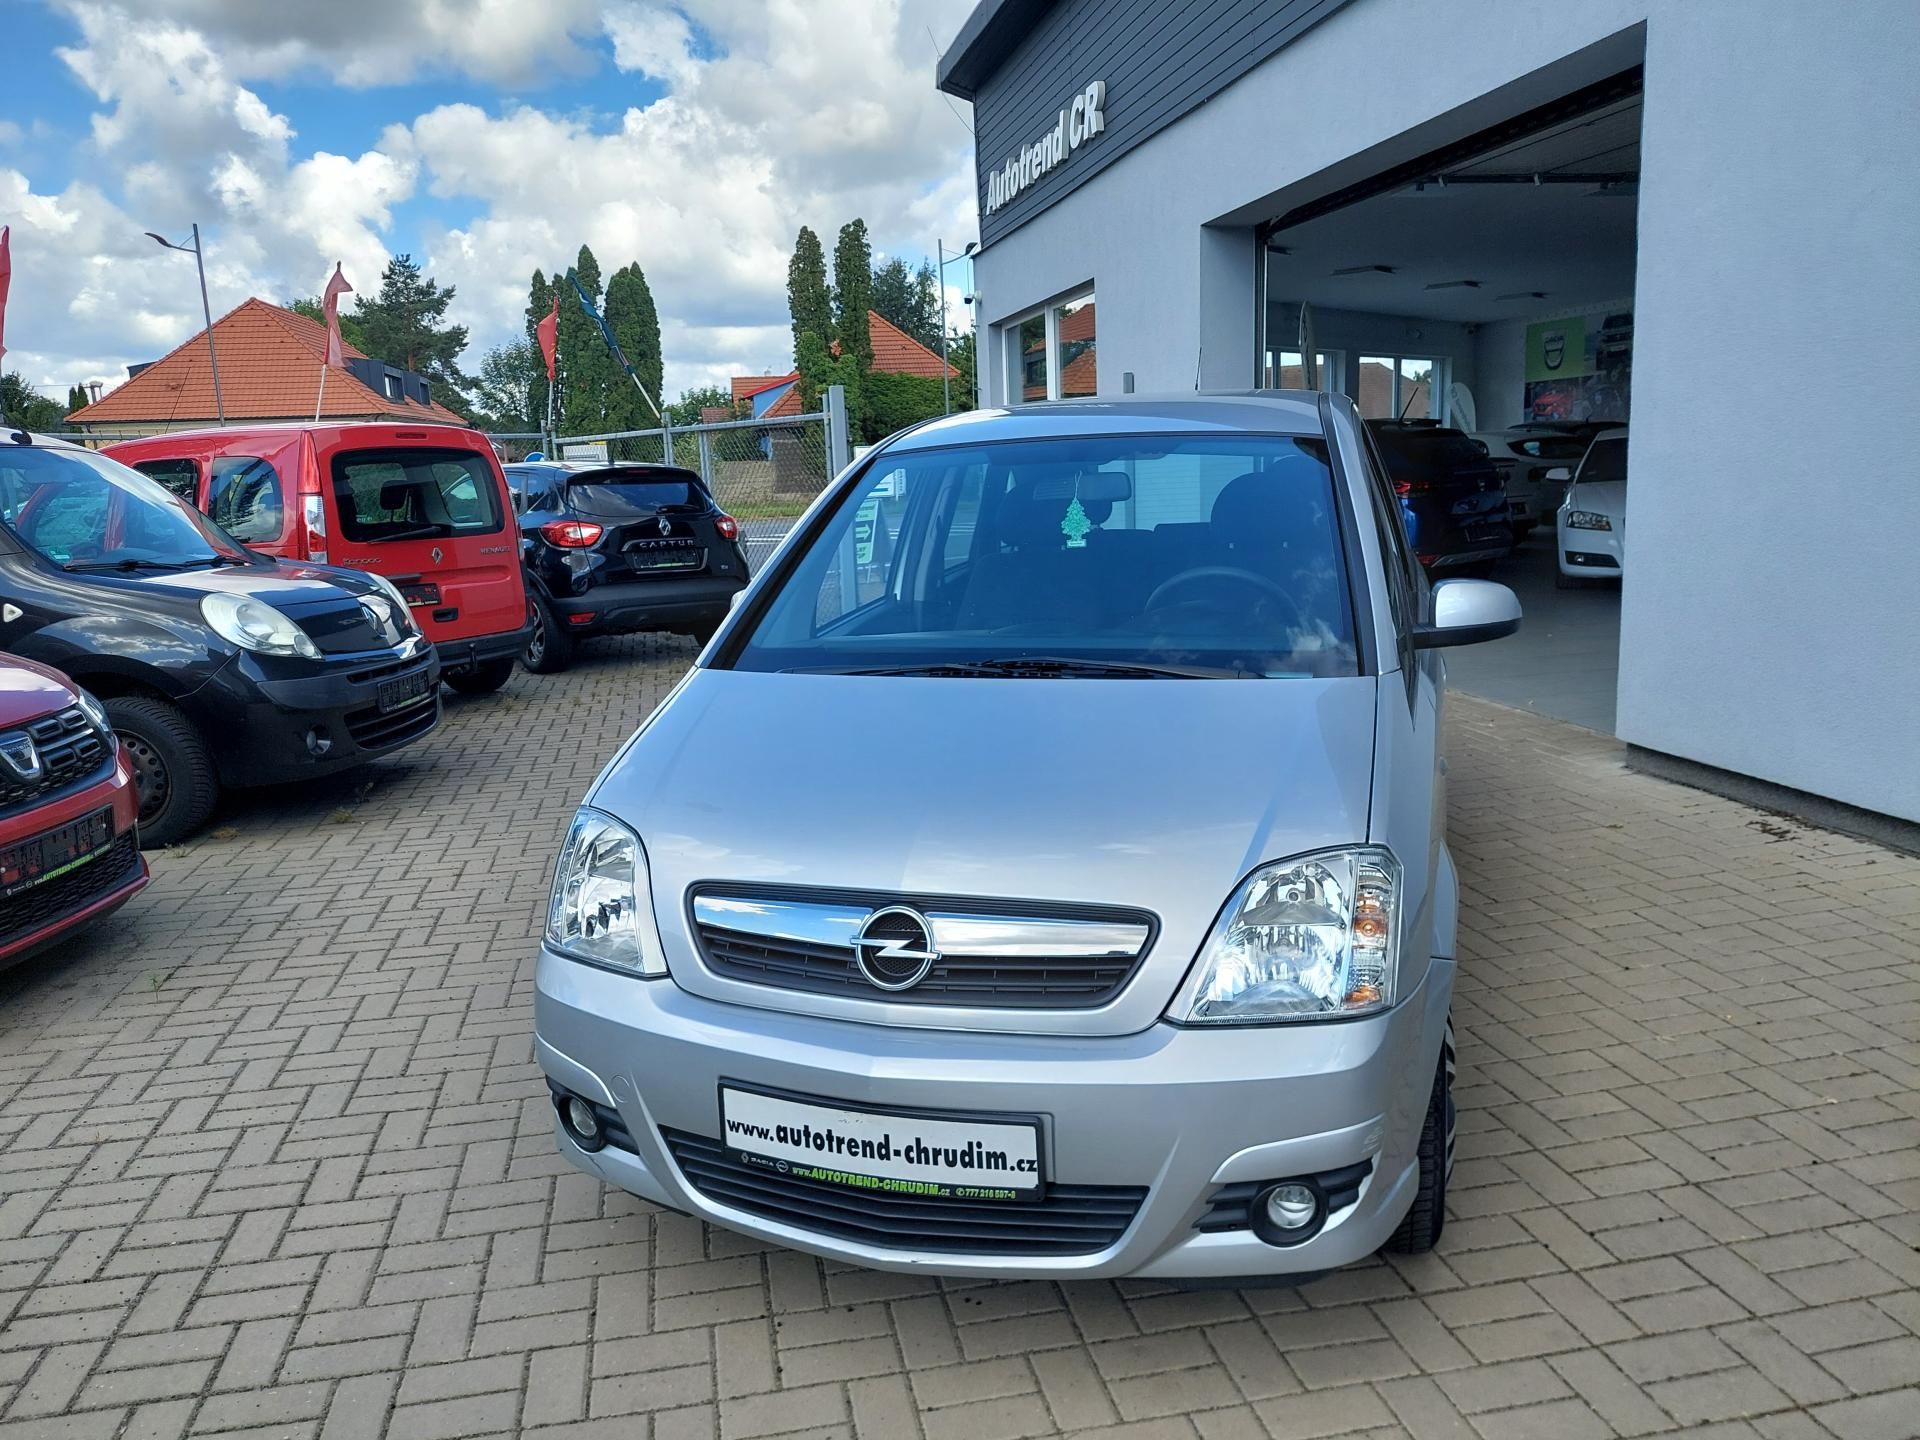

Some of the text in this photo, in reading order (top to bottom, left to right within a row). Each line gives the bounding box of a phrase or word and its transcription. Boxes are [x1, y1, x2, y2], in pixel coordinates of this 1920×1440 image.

[986, 80, 1106, 216] Autotrend CR
[639, 539, 694, 549] CAPTUR
[727, 1119, 1037, 1172] www.autotrend-chrudim.cz
[792, 1167, 950, 1196] www.AUTOTREND-CHRUDIM.cz
